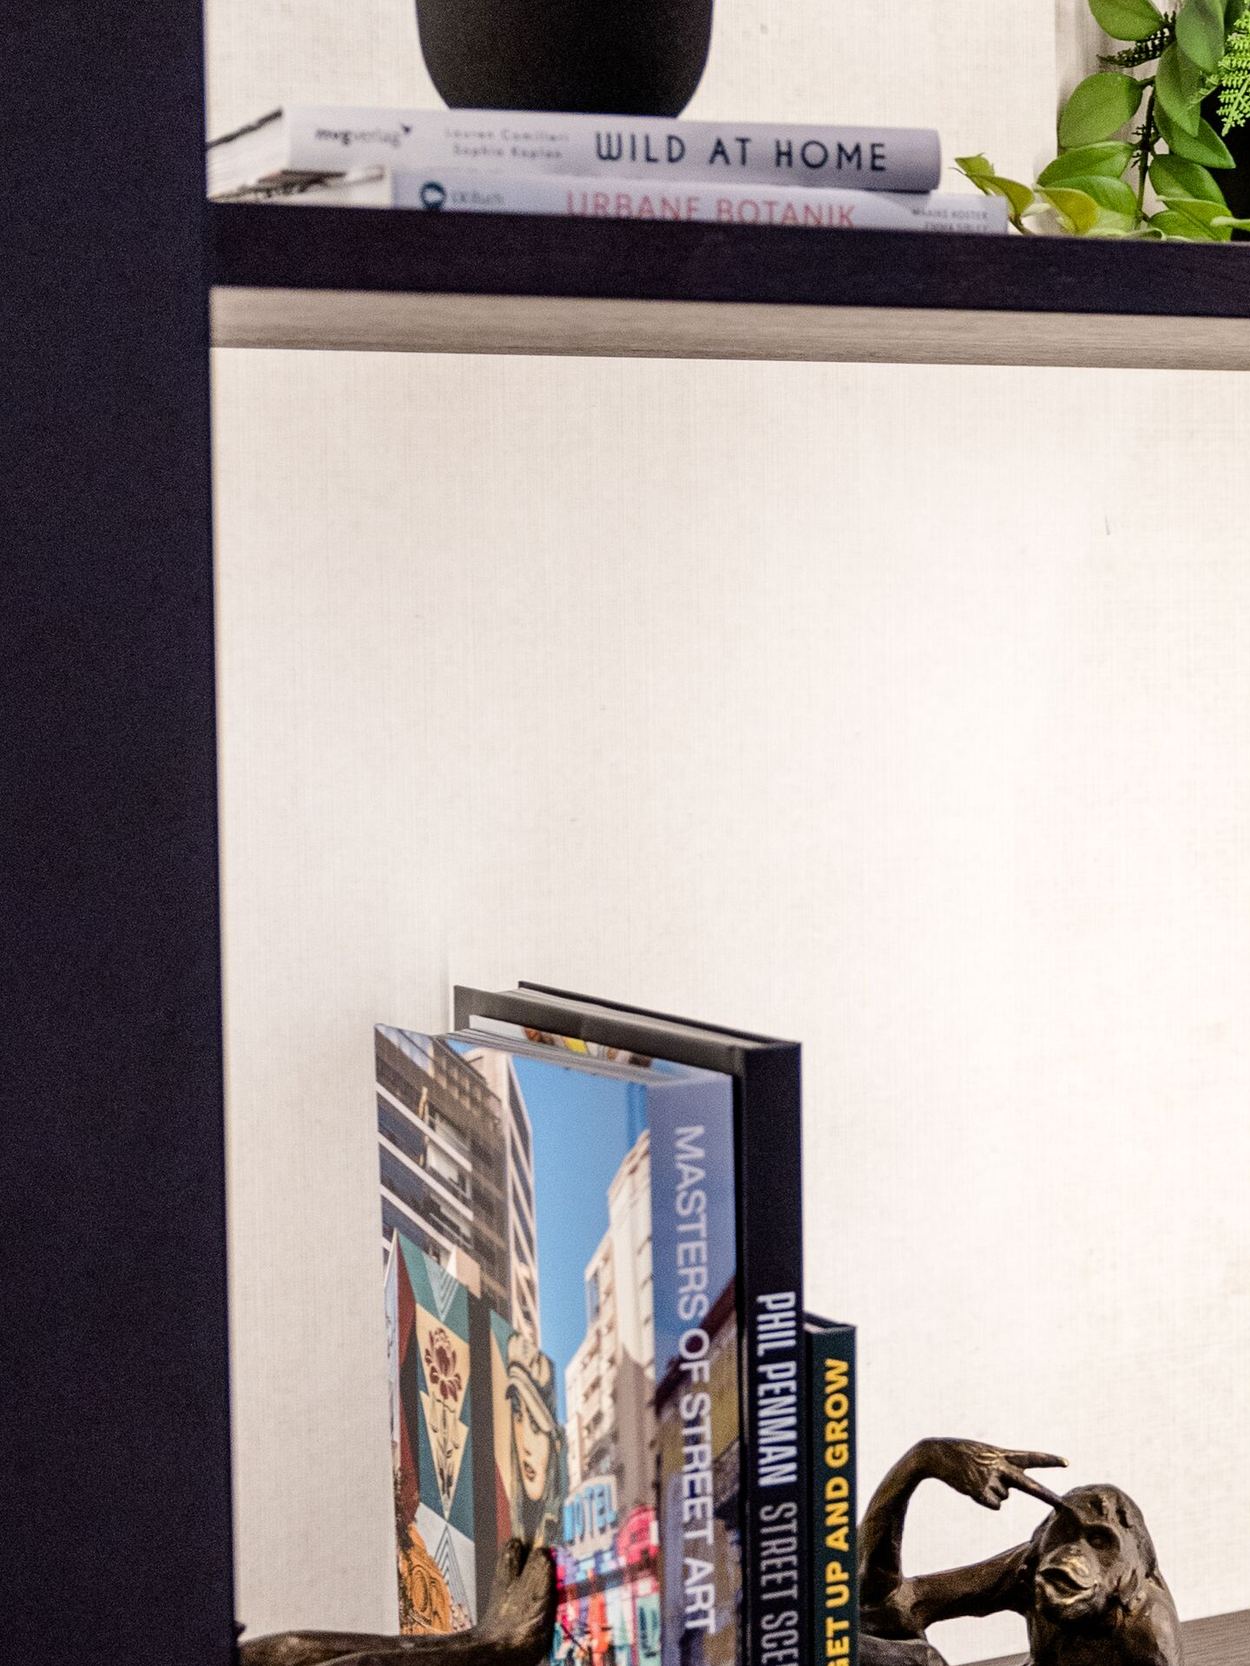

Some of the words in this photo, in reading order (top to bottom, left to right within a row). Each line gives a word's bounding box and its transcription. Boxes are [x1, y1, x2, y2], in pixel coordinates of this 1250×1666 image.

[596, 131, 686, 165] WILD
[709, 137, 752, 166] AT
[775, 139, 888, 173] HOME
[566, 191, 698, 221] URBANE
[716, 199, 855, 228] BOTANIK
[674, 1124, 710, 1321] MASTERS
[678, 1328, 711, 1384] OF
[756, 1291, 797, 1357] PHIL
[757, 1360, 798, 1487] PENMAN
[824, 1357, 850, 1468] GROW
[679, 1392, 715, 1545] STREET
[759, 1501, 799, 1601] STREET
[825, 1476, 850, 1552] AND
[683, 1556, 716, 1637] ART
[825, 1561, 850, 1609] UP
[760, 1610, 799, 1666] SCE
